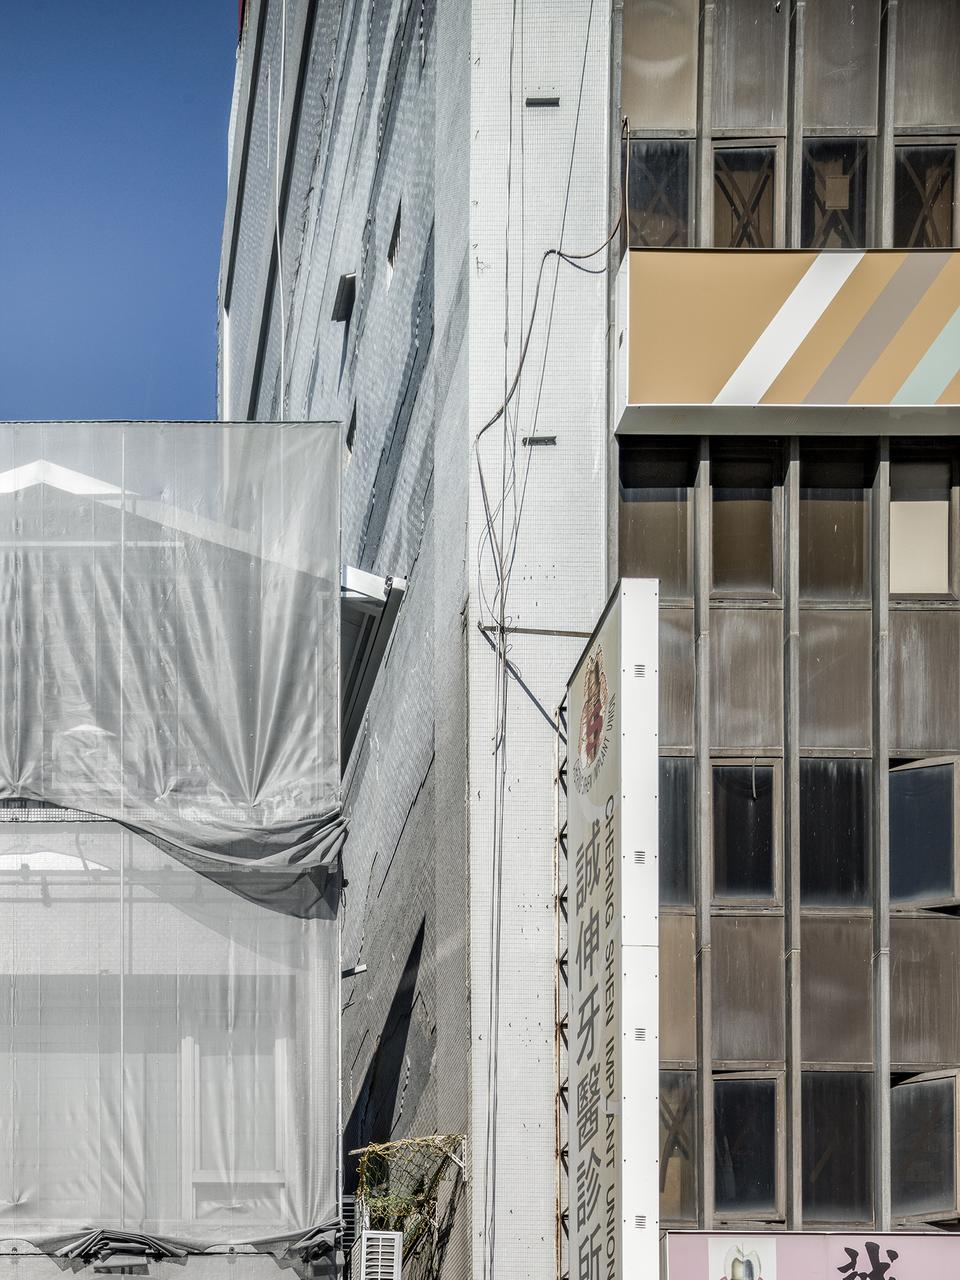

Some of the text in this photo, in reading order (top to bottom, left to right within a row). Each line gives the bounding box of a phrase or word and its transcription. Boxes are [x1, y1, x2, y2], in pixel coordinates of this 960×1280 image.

[605, 795, 615, 929] CHERNG
[605, 939, 615, 1027] SHEN
[605, 1036, 616, 1168] IMPLANT
